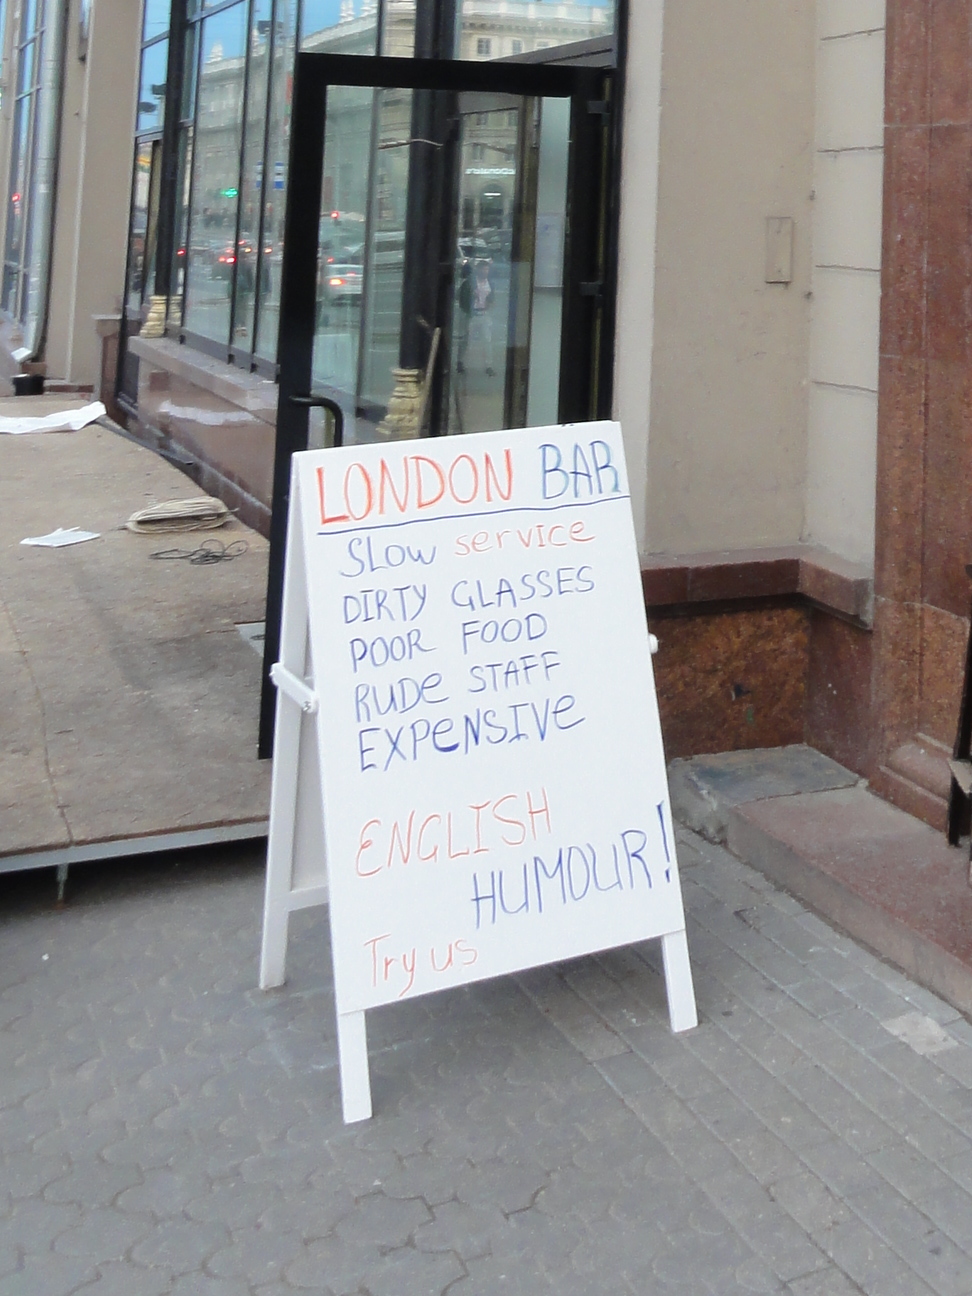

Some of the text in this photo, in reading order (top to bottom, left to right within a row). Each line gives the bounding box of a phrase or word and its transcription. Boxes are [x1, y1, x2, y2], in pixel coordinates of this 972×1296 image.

[316, 440, 619, 525] LONDON BAR
[342, 565, 595, 625] DIRTY GLASSES
[350, 613, 547, 673] POOR FOOD
[468, 651, 561, 694] STAFF
[355, 787, 552, 877] ENGLISH
[471, 799, 672, 930] HUMOUR!
[364, 933, 479, 997] Try us
